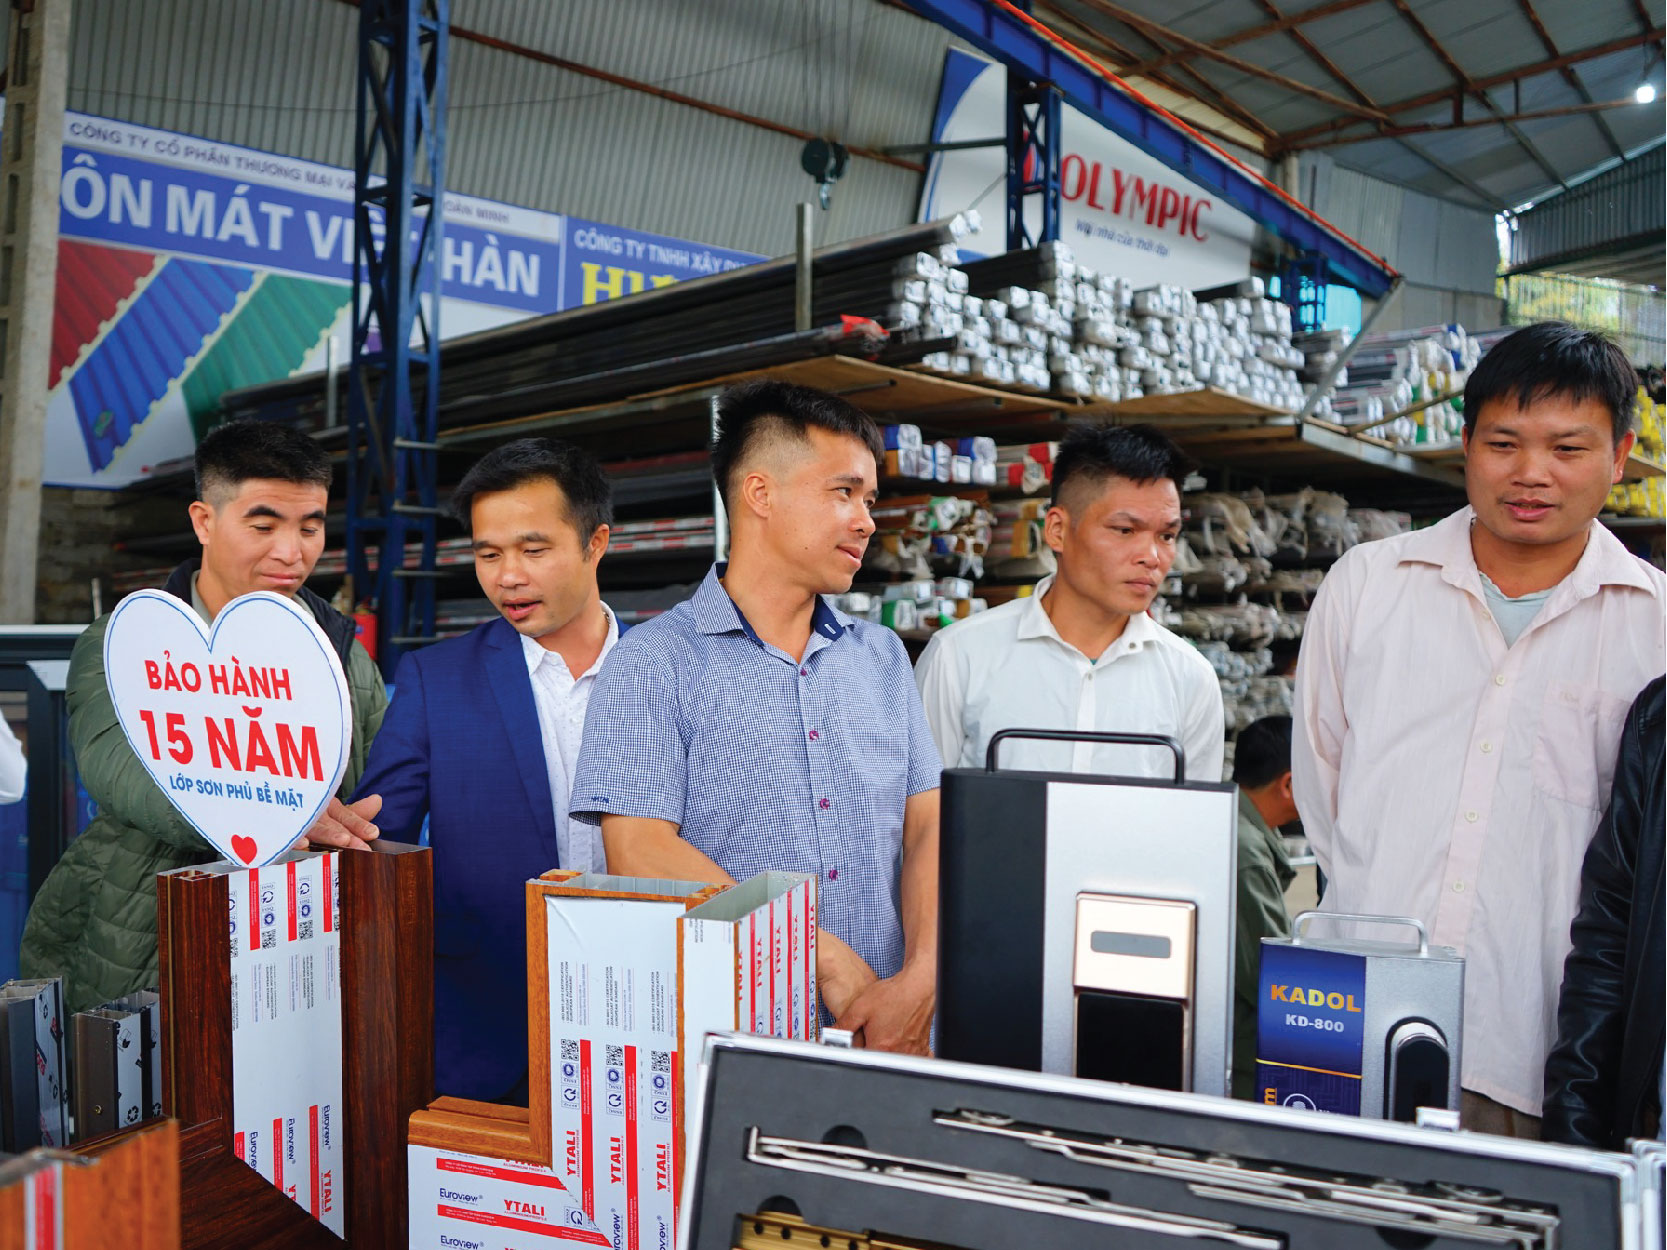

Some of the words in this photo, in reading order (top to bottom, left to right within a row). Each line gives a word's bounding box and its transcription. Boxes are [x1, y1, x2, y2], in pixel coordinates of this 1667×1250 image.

[128, 133, 148, 150] TY
[1060, 153, 1212, 243] OLYMPIC
[165, 183, 294, 252] MÁT
[443, 233, 541, 297] HÀN
[574, 227, 623, 255] CÔNG
[624, 238, 646, 260] TY
[649, 244, 690, 268] TNHH
[144, 649, 201, 693] BẢO
[208, 655, 292, 700] HÀNH
[139, 709, 194, 765] 15
[204, 705, 324, 782] NĂM
[169, 772, 193, 791] LỚP
[196, 779, 224, 796] SƠN
[226, 781, 252, 800] PHỦ
[256, 781, 272, 803] BỀ
[274, 787, 304, 812] MẶT
[1270, 984, 1362, 1013] KADOL
[1285, 1013, 1345, 1033] KD-800
[250, 1131, 258, 1170] Eurovie
[566, 1130, 577, 1176] YTALI
[610, 1136, 622, 1184] YTALI
[656, 1144, 667, 1191] YTALI
[324, 1169, 332, 1213] YTALI
[439, 1187, 478, 1202] Euroview
[503, 1199, 545, 1216] YTALI
[440, 1235, 479, 1250] Euroview
[613, 1213, 621, 1250] roview
